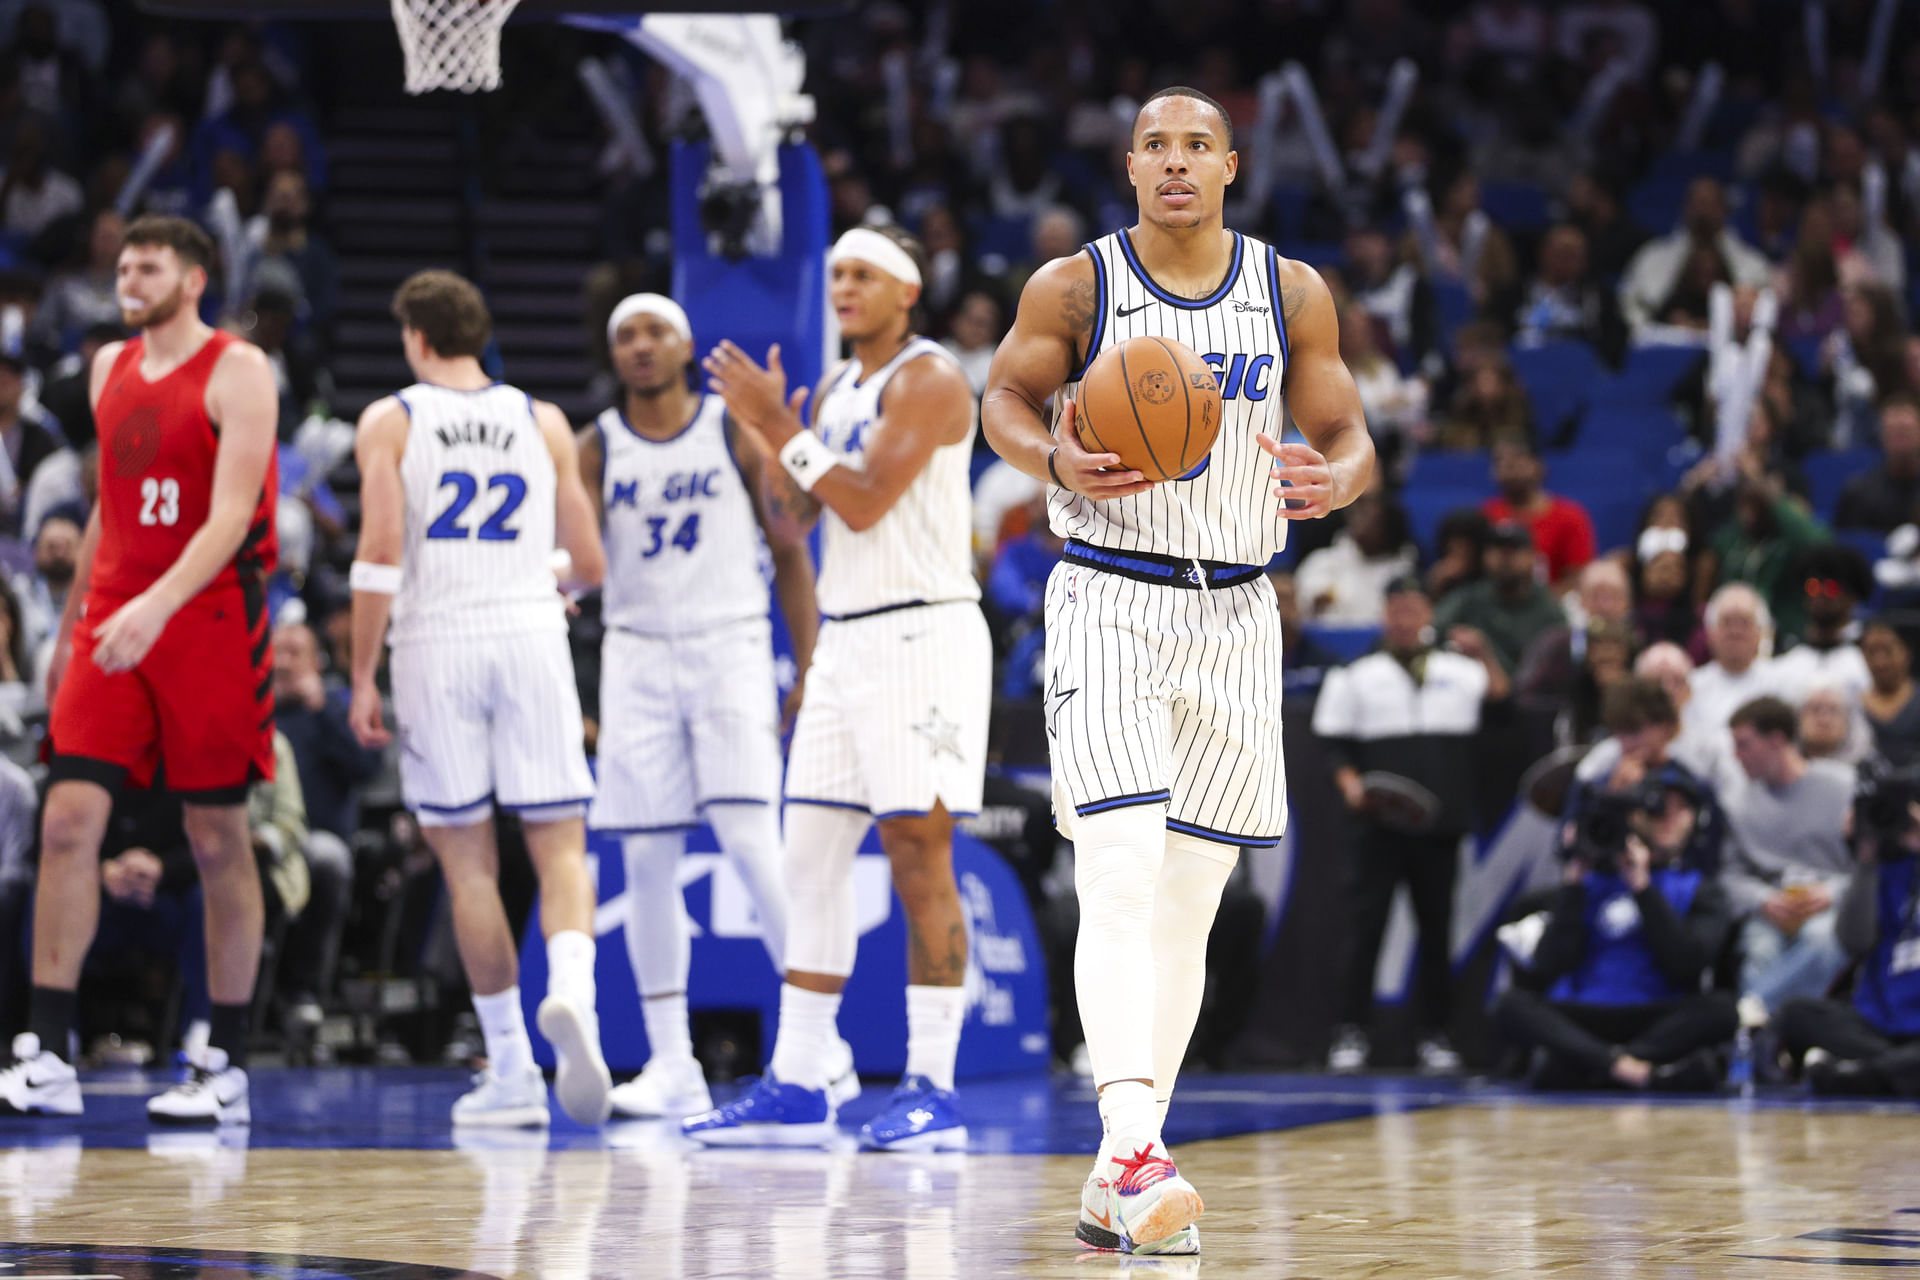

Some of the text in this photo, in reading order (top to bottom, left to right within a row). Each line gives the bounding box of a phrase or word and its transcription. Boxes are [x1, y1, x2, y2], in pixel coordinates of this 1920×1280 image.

[1228, 299, 1270, 318] Disney
[1200, 352, 1275, 402] GIC
[139, 476, 180, 527] 23
[426, 470, 528, 541] 22
[609, 467, 721, 508] MGIC
[641, 513, 700, 559] 34
